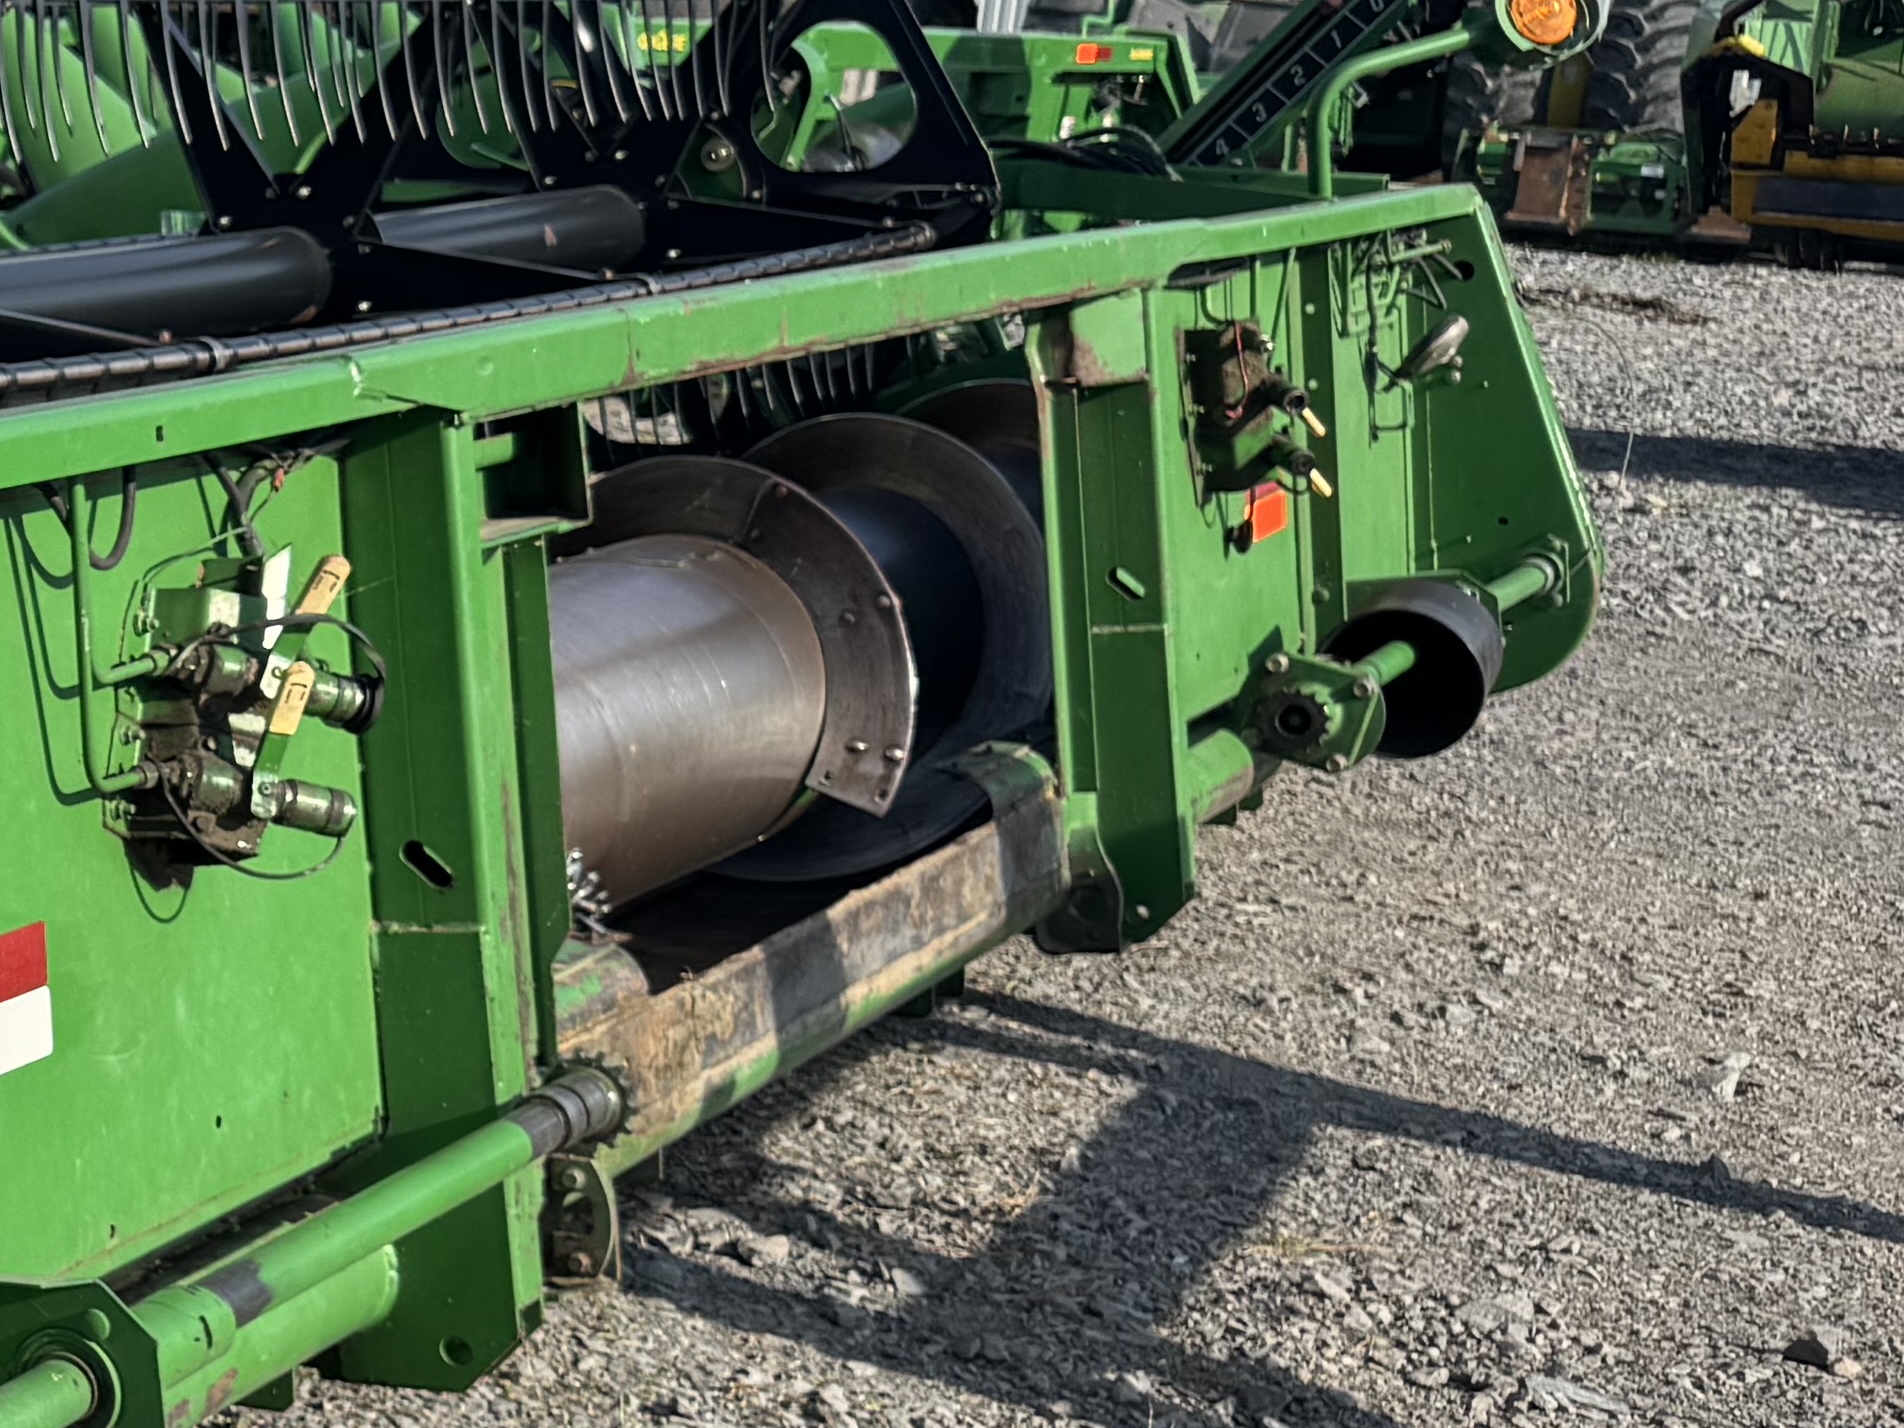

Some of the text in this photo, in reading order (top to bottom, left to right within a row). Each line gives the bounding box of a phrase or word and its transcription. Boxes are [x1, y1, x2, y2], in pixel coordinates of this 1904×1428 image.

[1330, 30, 1341, 48] 1
[1290, 65, 1306, 86] 2
[1252, 103, 1266, 122] 3
[1216, 138, 1229, 156] 4
